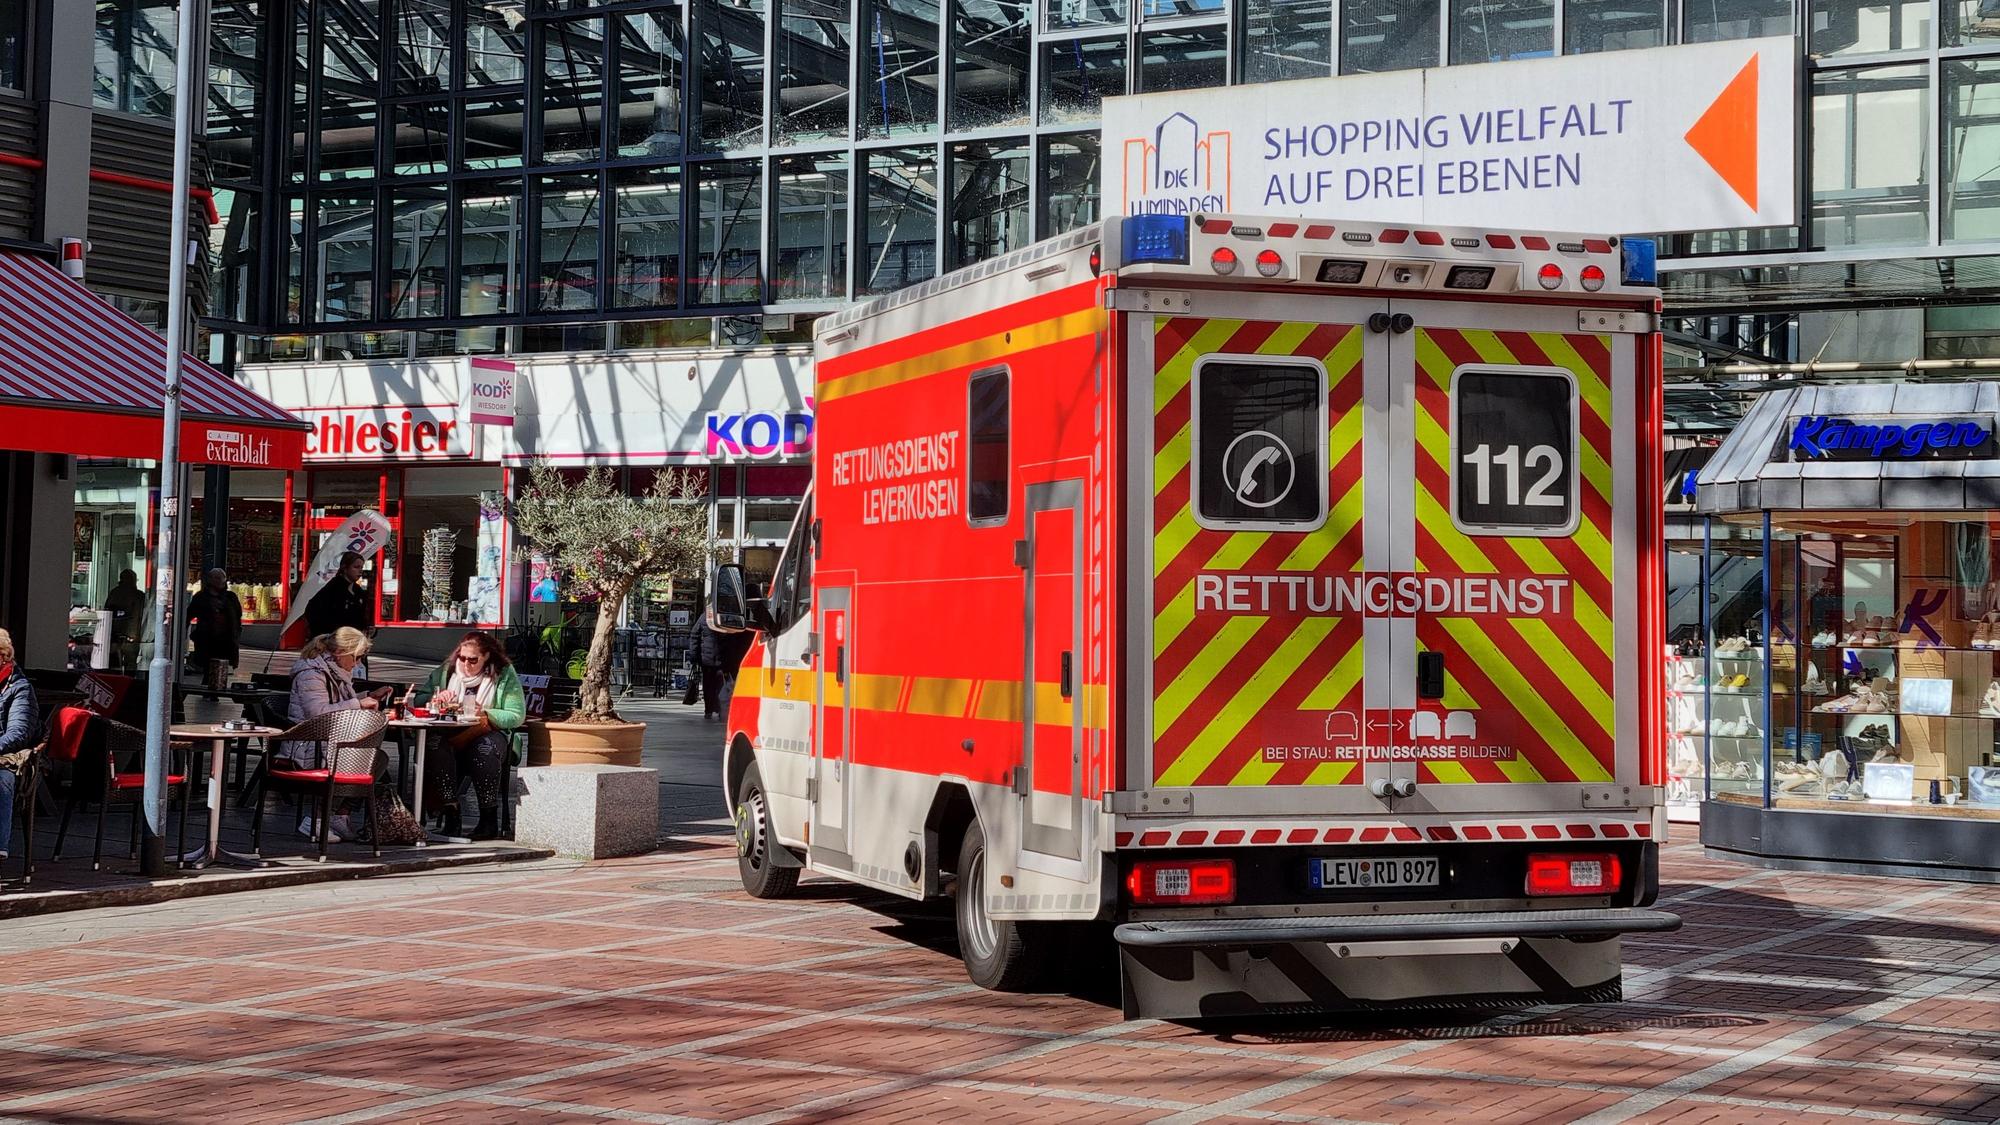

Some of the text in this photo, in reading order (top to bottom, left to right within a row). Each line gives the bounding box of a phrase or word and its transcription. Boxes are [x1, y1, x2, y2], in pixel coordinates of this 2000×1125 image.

[1263, 99, 1633, 161] SHOPPING VIELFALT
[1163, 167, 1189, 189] DIE
[1263, 152, 1581, 206] AUF DREI EBENEN
[477, 401, 508, 410] WIESDORF
[206, 433, 273, 465] extrablatt
[302, 410, 457, 454] chlesier
[706, 413, 815, 455] KOD
[1788, 415, 1991, 459] Kämpgen
[832, 430, 959, 487] RETTUNGSDIENST
[1463, 443, 1565, 507] 112
[863, 477, 959, 526] LEVERKUSEN
[1196, 574, 1569, 615] RETTUNGSDIENST
[1266, 745, 1511, 760] BEI STAU: RETTUNGSGASSE BILDEN!
[1322, 862, 1359, 886] LEV
[1373, 861, 1398, 884] RD
[1402, 860, 1437, 884] 897
